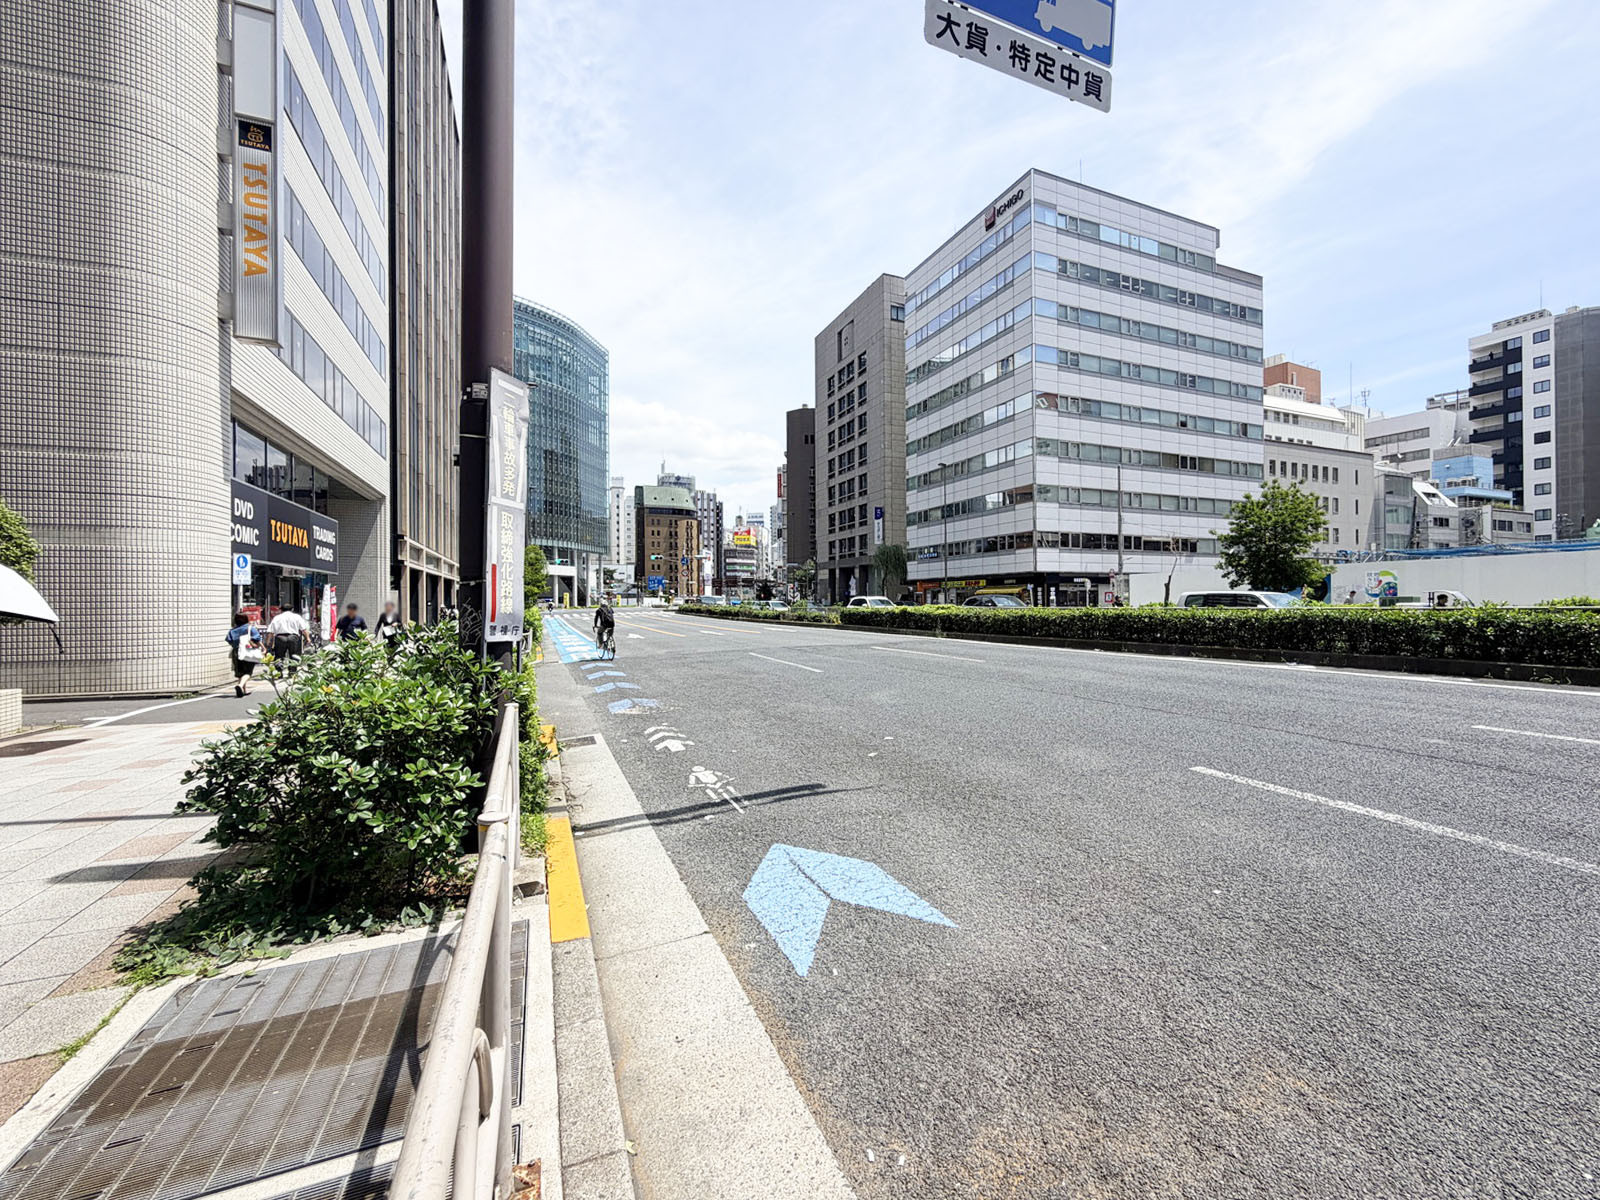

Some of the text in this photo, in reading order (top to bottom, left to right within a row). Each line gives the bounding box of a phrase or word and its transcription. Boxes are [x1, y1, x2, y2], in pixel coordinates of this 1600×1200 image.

[936, 12, 1103, 102] 大貨・特定中貨
[240, 139, 270, 150] TSUTAYA
[996, 189, 1024, 218] ICHIGO
[243, 163, 268, 277] TSUTAYA
[502, 392, 516, 497] 二輪車事故多発
[234, 497, 254, 520] DVD
[229, 522, 260, 546] COMIC
[270, 519, 309, 549] TSUTAYA
[312, 525, 336, 546] TRADING
[315, 545, 334, 562] CARDS
[500, 510, 514, 615] 取締強化路線
[489, 624, 520, 637] 警視庁
